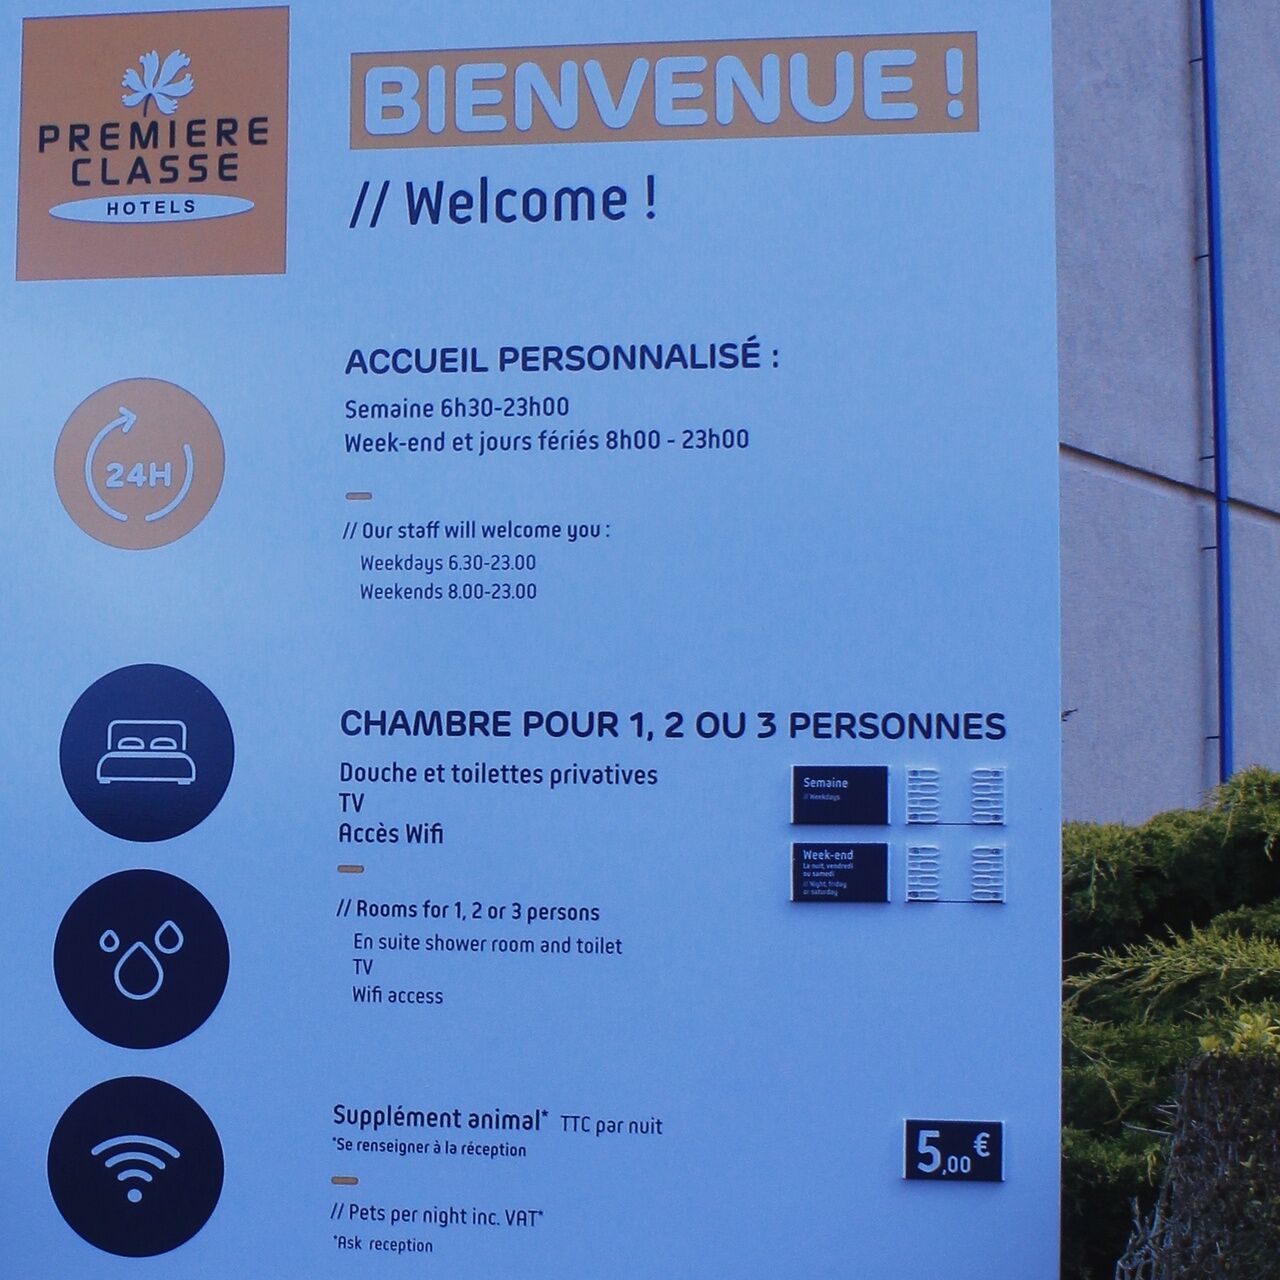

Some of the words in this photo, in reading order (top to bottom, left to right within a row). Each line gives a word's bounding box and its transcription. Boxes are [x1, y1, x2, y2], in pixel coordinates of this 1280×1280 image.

[363, 48, 917, 136] BIENVENUE
[38, 117, 269, 153] PREMIERE
[71, 153, 238, 186] CLASSE
[106, 199, 196, 217] HOTELS
[405, 175, 628, 226] Welcome
[344, 347, 489, 375] ACCUEIL
[499, 334, 761, 373] PERSONNALISÉ
[345, 397, 434, 420] Semaine
[441, 395, 569, 418] 6h30-23h00
[344, 430, 446, 454] Week-end
[452, 432, 474, 452] et
[478, 429, 532, 457] jours
[537, 428, 600, 452] fériés
[605, 429, 661, 451] 8h00
[682, 428, 750, 450] 23h00
[105, 462, 172, 488] 24H
[362, 521, 394, 540] Our
[397, 520, 441, 540] staff
[444, 520, 476, 540] will
[481, 519, 562, 539] welcome
[567, 524, 601, 543] you
[360, 553, 444, 576] Weekdays
[448, 553, 536, 571] 6.30-23.00
[360, 582, 443, 600] Weekends
[447, 582, 537, 600] 8.00-23.00
[340, 709, 512, 738] CHAMBRE
[523, 710, 619, 739] POUR
[629, 711, 654, 742] 1,
[664, 711, 685, 739] 2
[695, 711, 747, 739] OU
[756, 712, 777, 740] 3
[789, 711, 1007, 741] PERSONNES
[340, 761, 418, 784] Douche
[423, 763, 446, 784] et
[450, 761, 544, 785] toilettes
[550, 762, 658, 790] privatives
[803, 777, 849, 788] Semaine
[338, 792, 365, 813] TV
[338, 821, 400, 844] Accès
[405, 822, 444, 845] Wifi
[803, 849, 854, 860] Week-end
[356, 899, 418, 919] Rooms
[421, 899, 450, 919] for
[454, 901, 467, 922] 1,
[472, 901, 483, 919] 2
[487, 905, 507, 921] or
[511, 902, 525, 920] 3
[527, 905, 600, 926] persons
[354, 932, 374, 950] En
[378, 932, 421, 951] suite
[425, 933, 488, 953] shower
[491, 938, 535, 953] room
[540, 935, 571, 954] and
[575, 935, 623, 955] toilet
[352, 957, 374, 976] TV
[352, 985, 383, 1004] Wifi
[387, 989, 444, 1005] access
[333, 1103, 462, 1132] Supplément
[560, 1114, 591, 1133] TTC
[595, 1119, 625, 1138] par
[628, 1116, 663, 1136] nuit
[356, 1137, 430, 1158] renseigner
[433, 1139, 442, 1155] à
[445, 1139, 458, 1155] la
[460, 1140, 527, 1161] réception
[349, 1203, 386, 1222] Pets
[390, 1208, 419, 1227] per
[422, 1205, 468, 1228] night
[472, 1206, 501, 1226] inc.
[369, 1237, 433, 1256] reception
